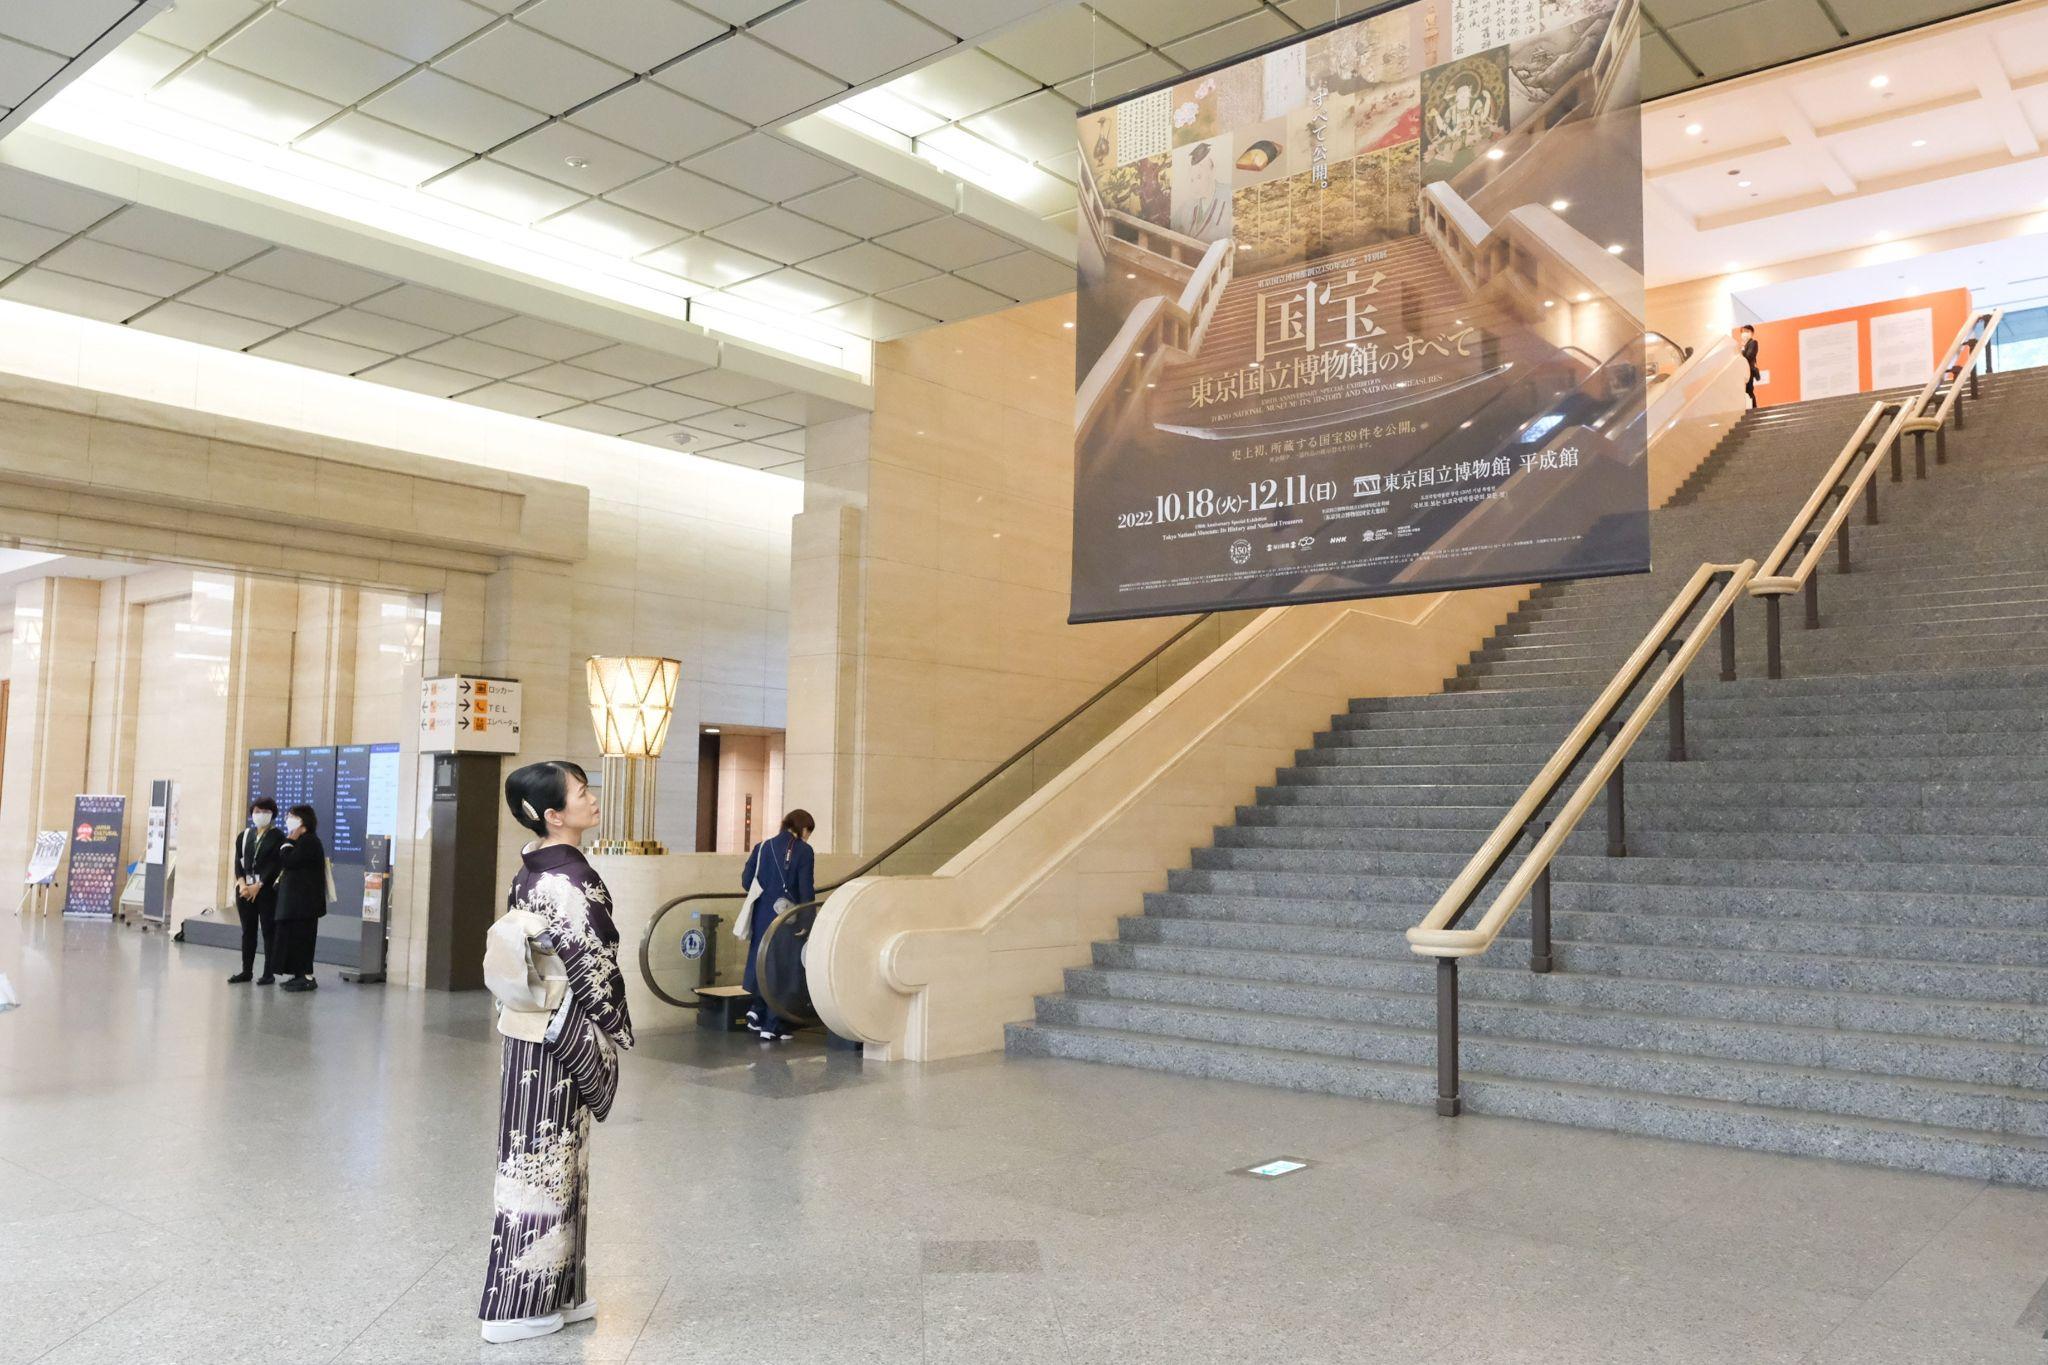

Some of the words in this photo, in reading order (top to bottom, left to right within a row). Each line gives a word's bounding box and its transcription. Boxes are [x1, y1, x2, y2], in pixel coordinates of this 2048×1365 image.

[1256, 270, 1387, 362] 国宝
[1188, 326, 1474, 409] 東京国立博物館のすべて
[1320, 385, 1345, 394] SPECIAL
[1211, 413, 1232, 423] TOKYO
[1233, 407, 1262, 418] NATIONAL
[1313, 393, 1342, 404] HISTORY
[1345, 389, 1361, 399] AND
[1362, 382, 1398, 395] NATIONAL
[1384, 455, 1511, 493] 東京国立博物館
[1519, 446, 1580, 474] 平成館
[1117, 510, 1153, 529] 2022
[1177, 530, 1197, 539] National
[1227, 525, 1245, 533] History
[1246, 523, 1257, 531] and
[1257, 520, 1278, 529] National
[1278, 518, 1304, 527] Treasures
[1329, 536, 1347, 544] NHK
[489, 686, 515, 695] ロッカー
[488, 704, 508, 713] TEL
[488, 718, 518, 727] エレベーター
